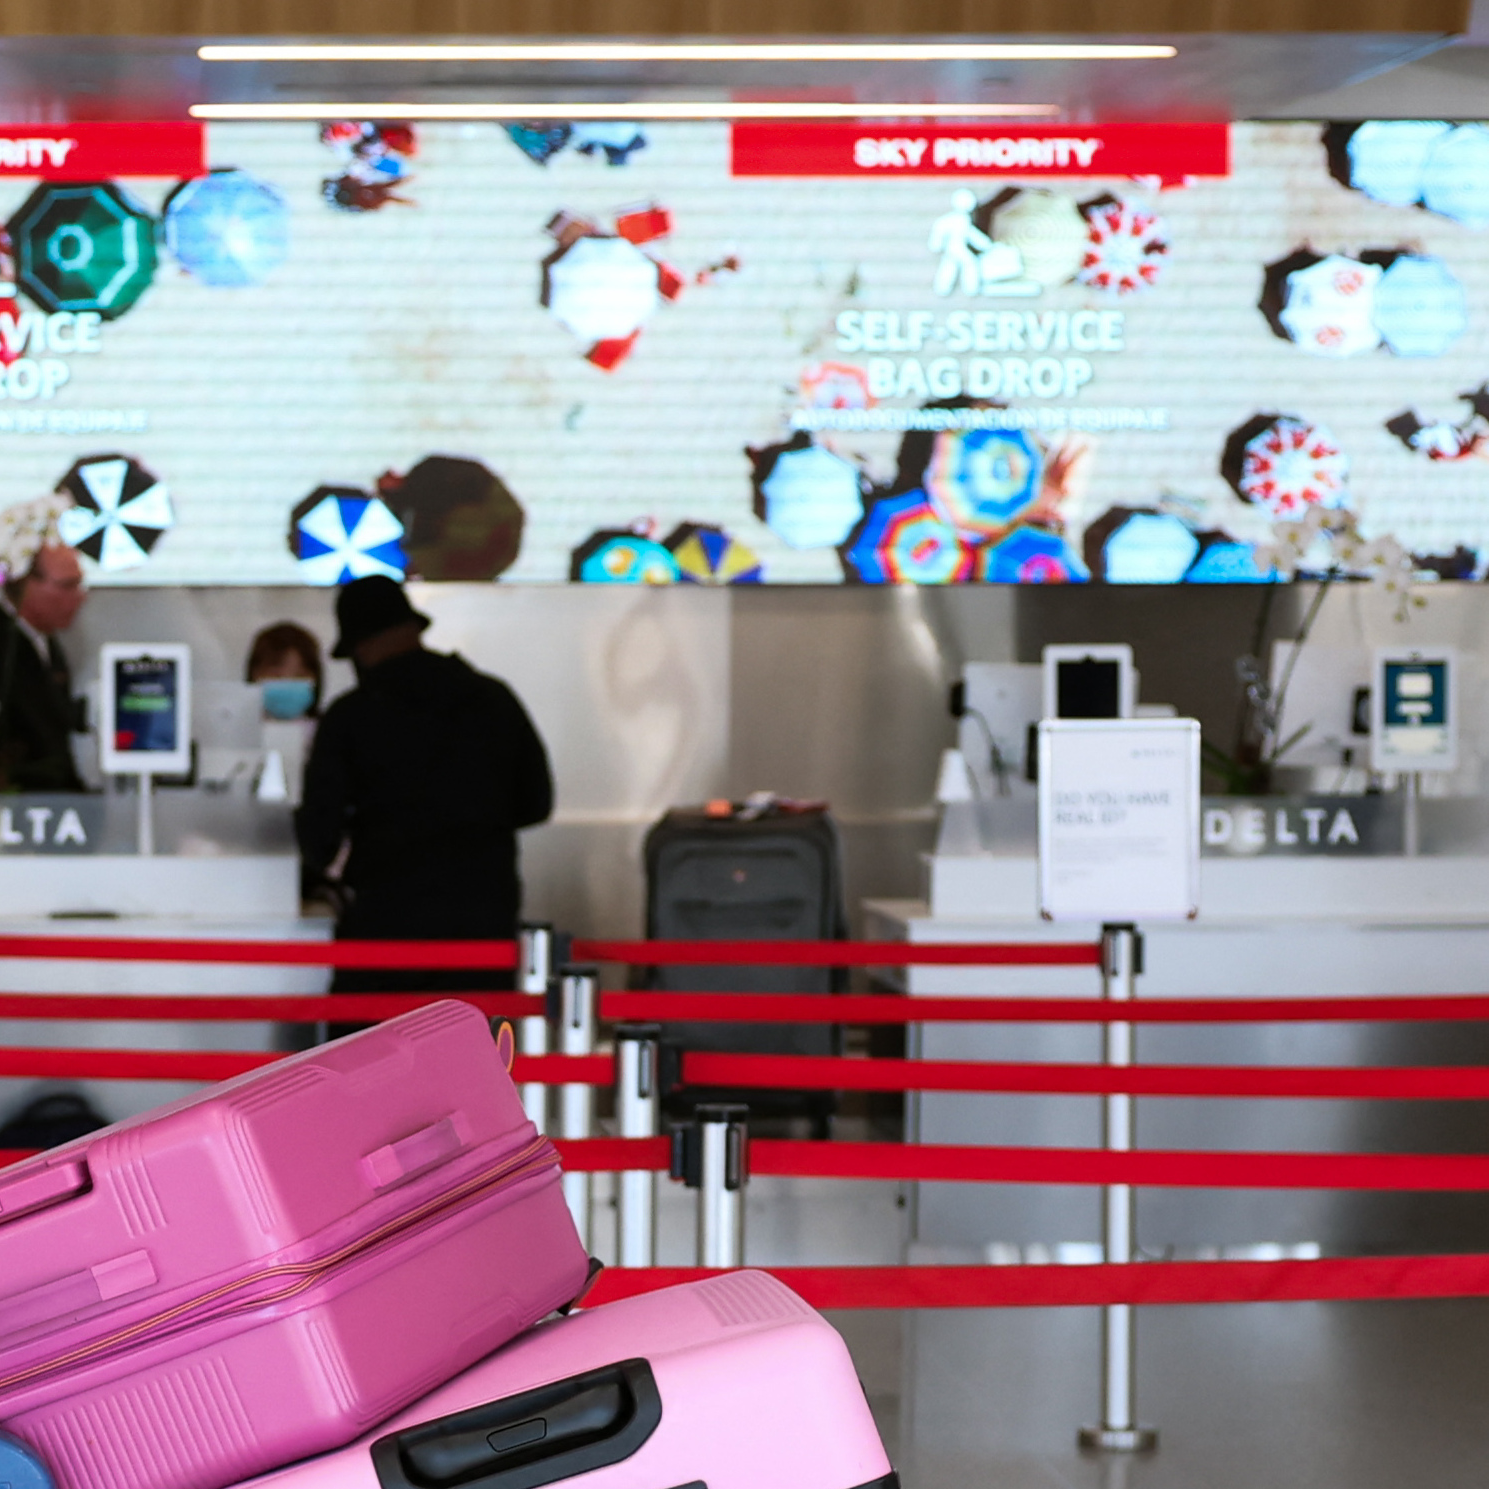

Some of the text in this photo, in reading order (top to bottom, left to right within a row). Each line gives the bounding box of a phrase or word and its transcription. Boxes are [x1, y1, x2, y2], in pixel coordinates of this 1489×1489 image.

[855, 139, 1098, 168] SKY PRIORITY
[836, 310, 1125, 353] SELF-SERVICE
[869, 358, 1094, 399] BAG DROP
[1204, 807, 1359, 845] DELTA
